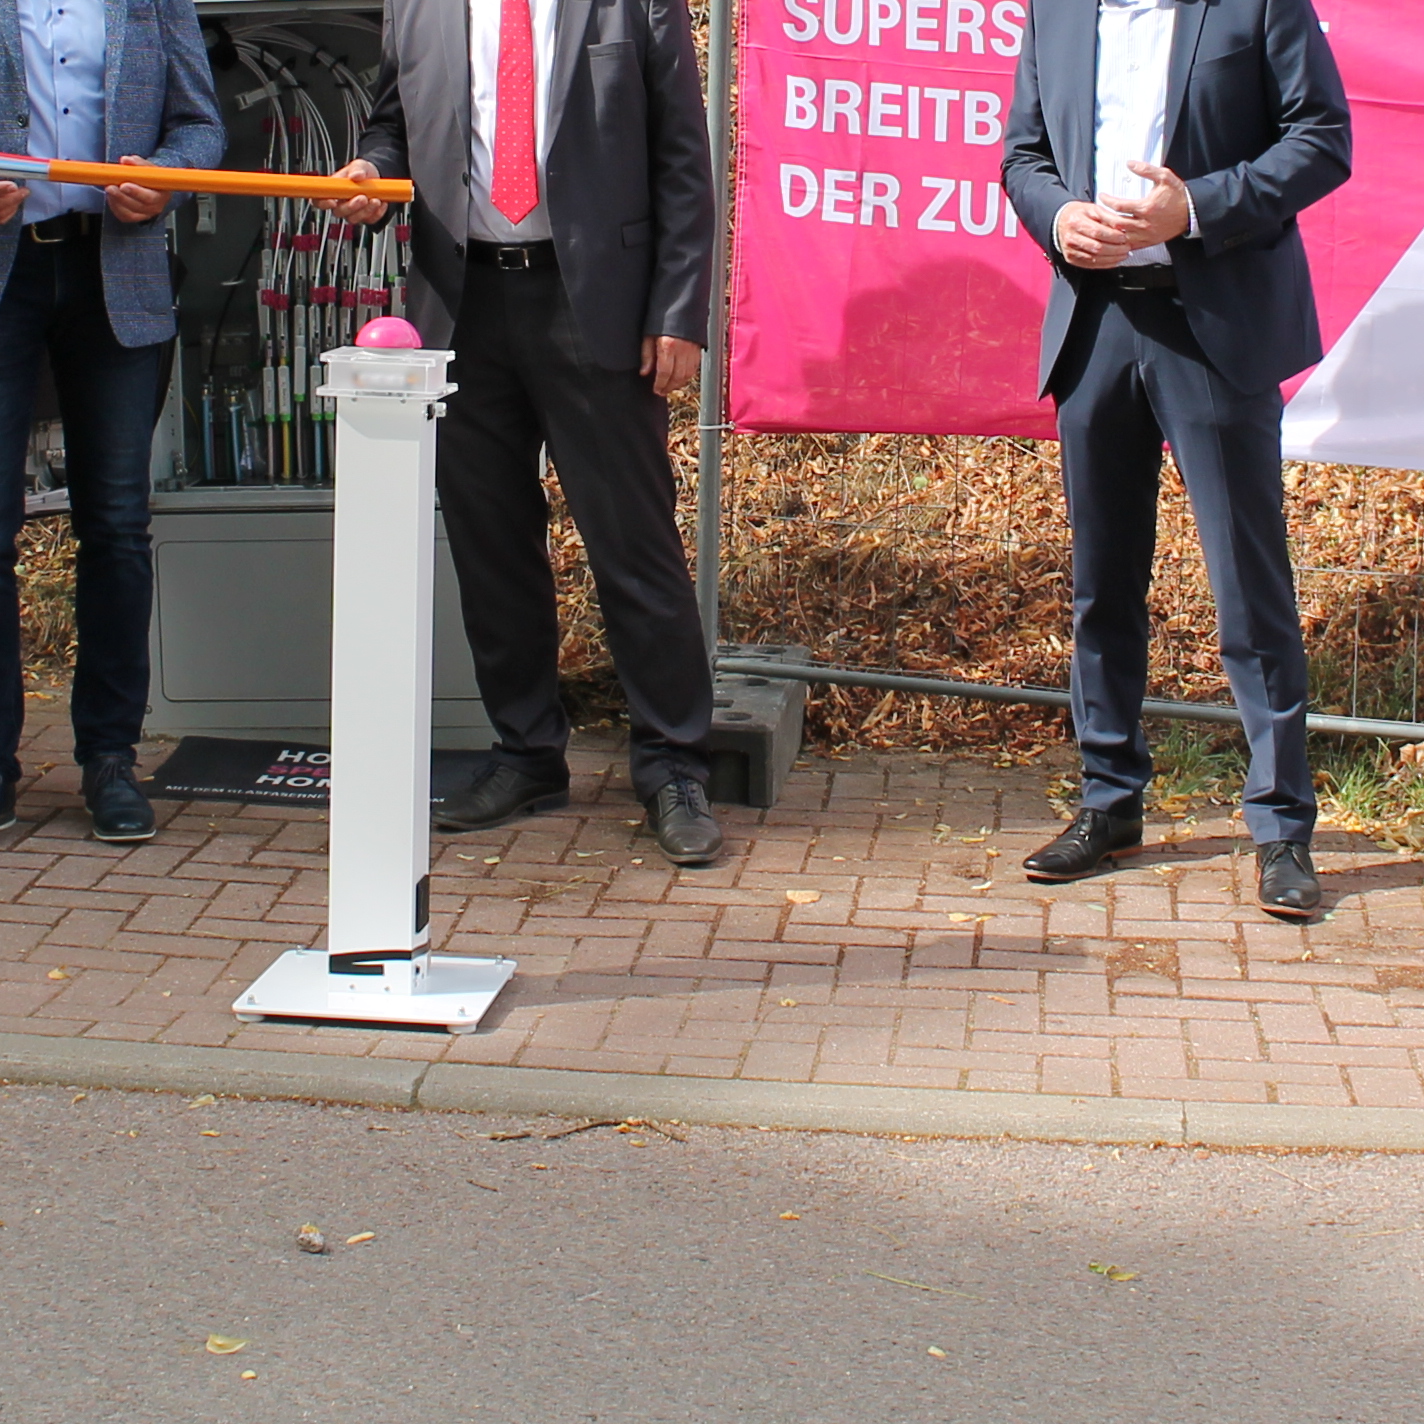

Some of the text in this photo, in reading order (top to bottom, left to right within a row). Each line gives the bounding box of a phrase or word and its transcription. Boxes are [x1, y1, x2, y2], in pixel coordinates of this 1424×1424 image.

[784, 74, 1003, 146] BREITB
[779, 163, 901, 228] DER
[266, 764, 331, 777] SPE
[277, 749, 332, 764] HO
